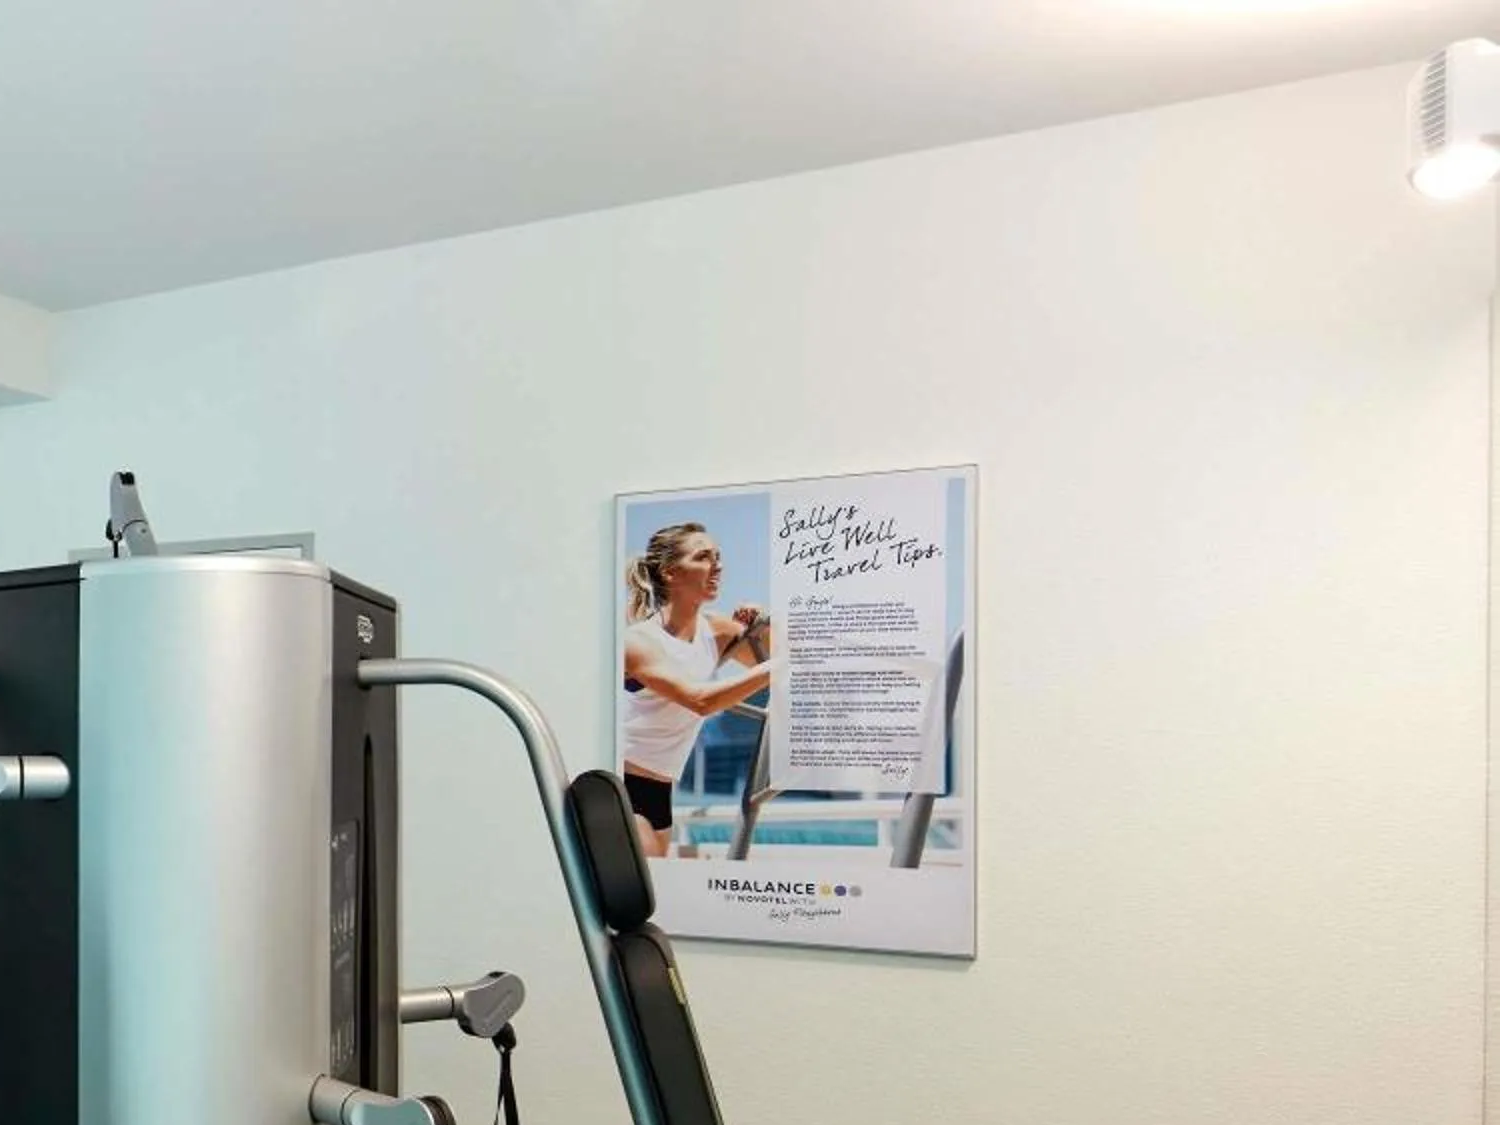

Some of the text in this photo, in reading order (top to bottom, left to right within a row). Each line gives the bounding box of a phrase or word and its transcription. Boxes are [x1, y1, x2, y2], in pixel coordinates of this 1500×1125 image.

[779, 504, 859, 541] Sally's
[783, 517, 897, 565] Live Well
[807, 537, 943, 583] Travel Tips.
[707, 878, 816, 896] INBALANCE
[737, 895, 787, 905] NOVOTEL
